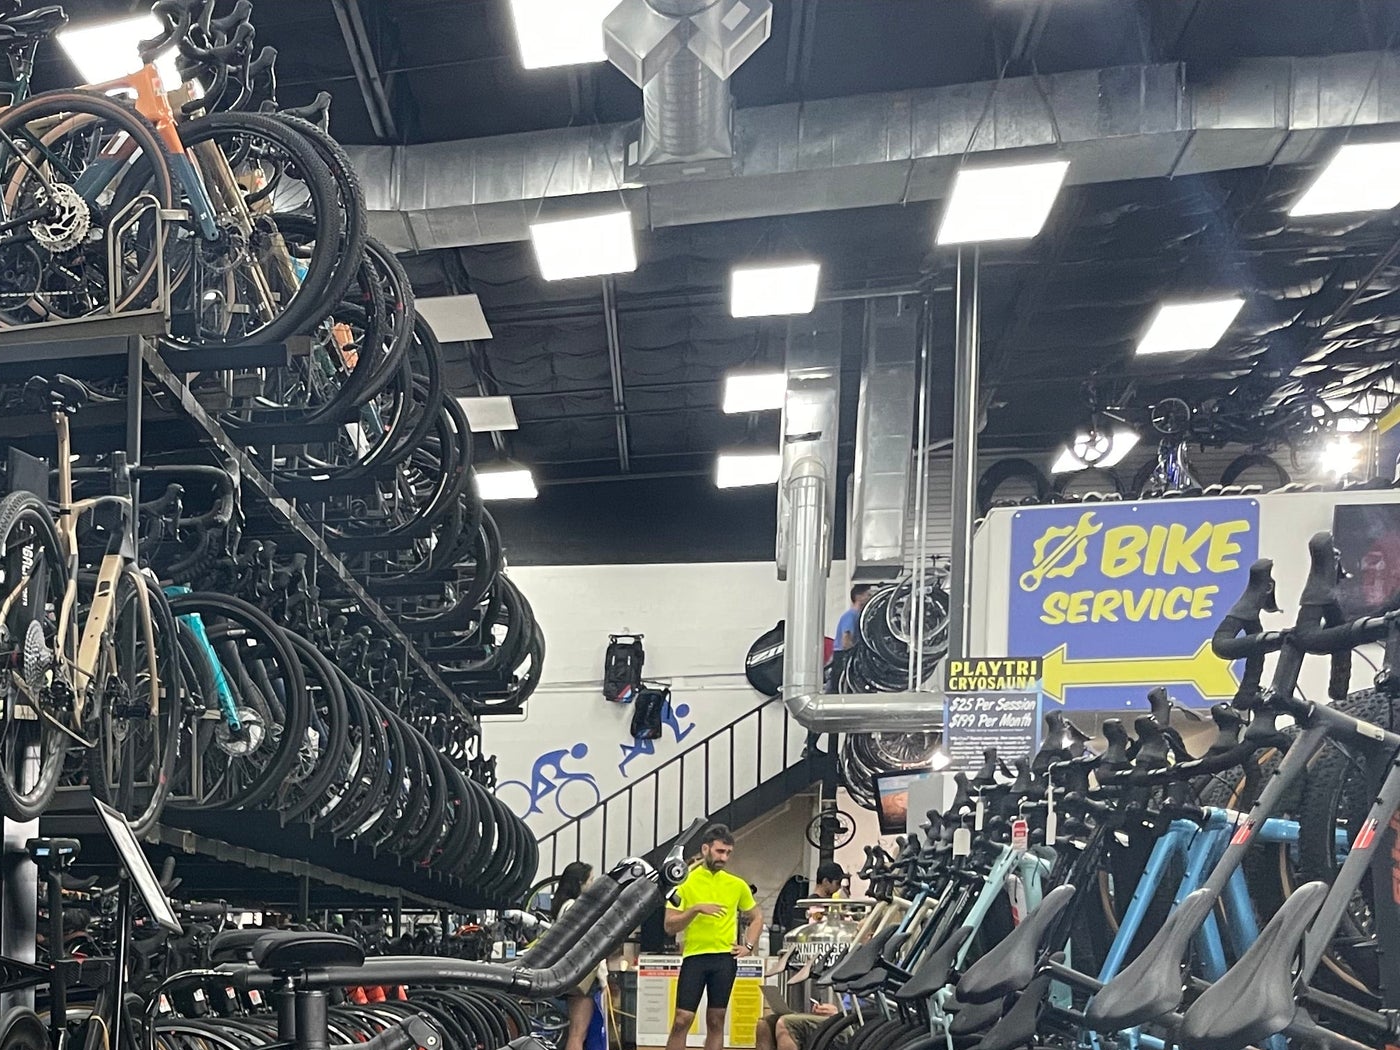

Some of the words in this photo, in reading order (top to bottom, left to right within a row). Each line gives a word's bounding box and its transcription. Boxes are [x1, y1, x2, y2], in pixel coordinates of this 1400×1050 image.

[1101, 520, 1250, 578] BIKE
[1040, 585, 1219, 625] SERVICE
[951, 661, 1037, 676] PLAYTRI
[949, 676, 1036, 690] CRYOSAUNA
[949, 697, 974, 711] $25
[975, 698, 995, 711] Per
[995, 698, 1036, 711] Session
[949, 713, 975, 728] $199
[978, 714, 998, 727] Per
[999, 713, 1032, 727] Month
